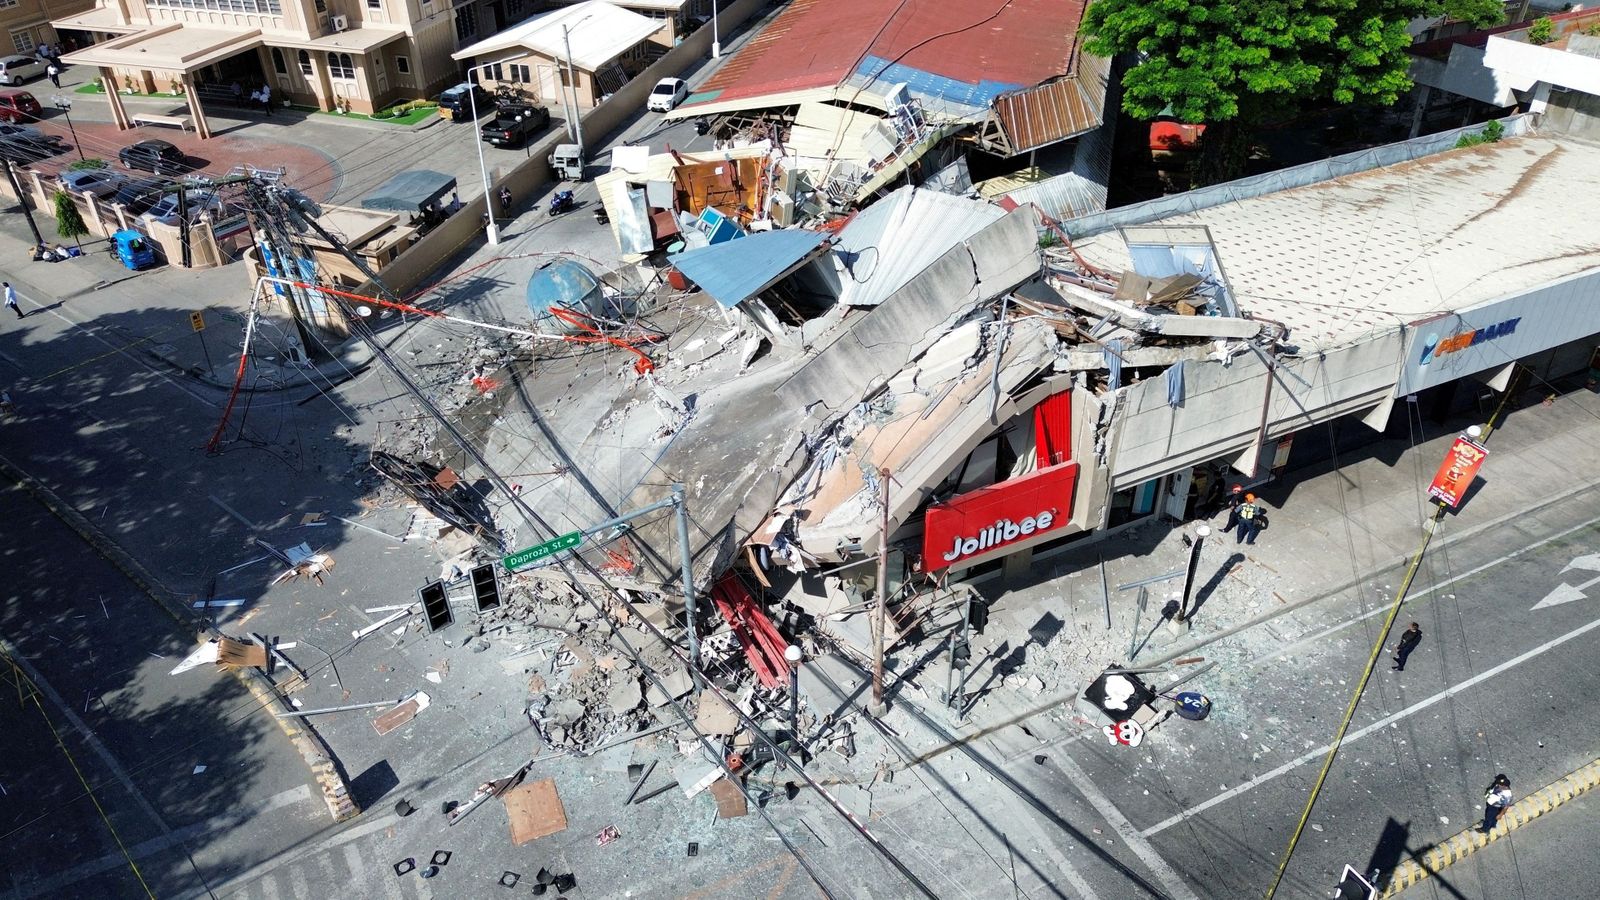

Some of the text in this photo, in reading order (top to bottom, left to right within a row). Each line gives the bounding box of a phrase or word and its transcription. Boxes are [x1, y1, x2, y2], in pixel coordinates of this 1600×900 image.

[510, 541, 564, 566] Daproza St.
[943, 509, 1053, 562] Jollibee
